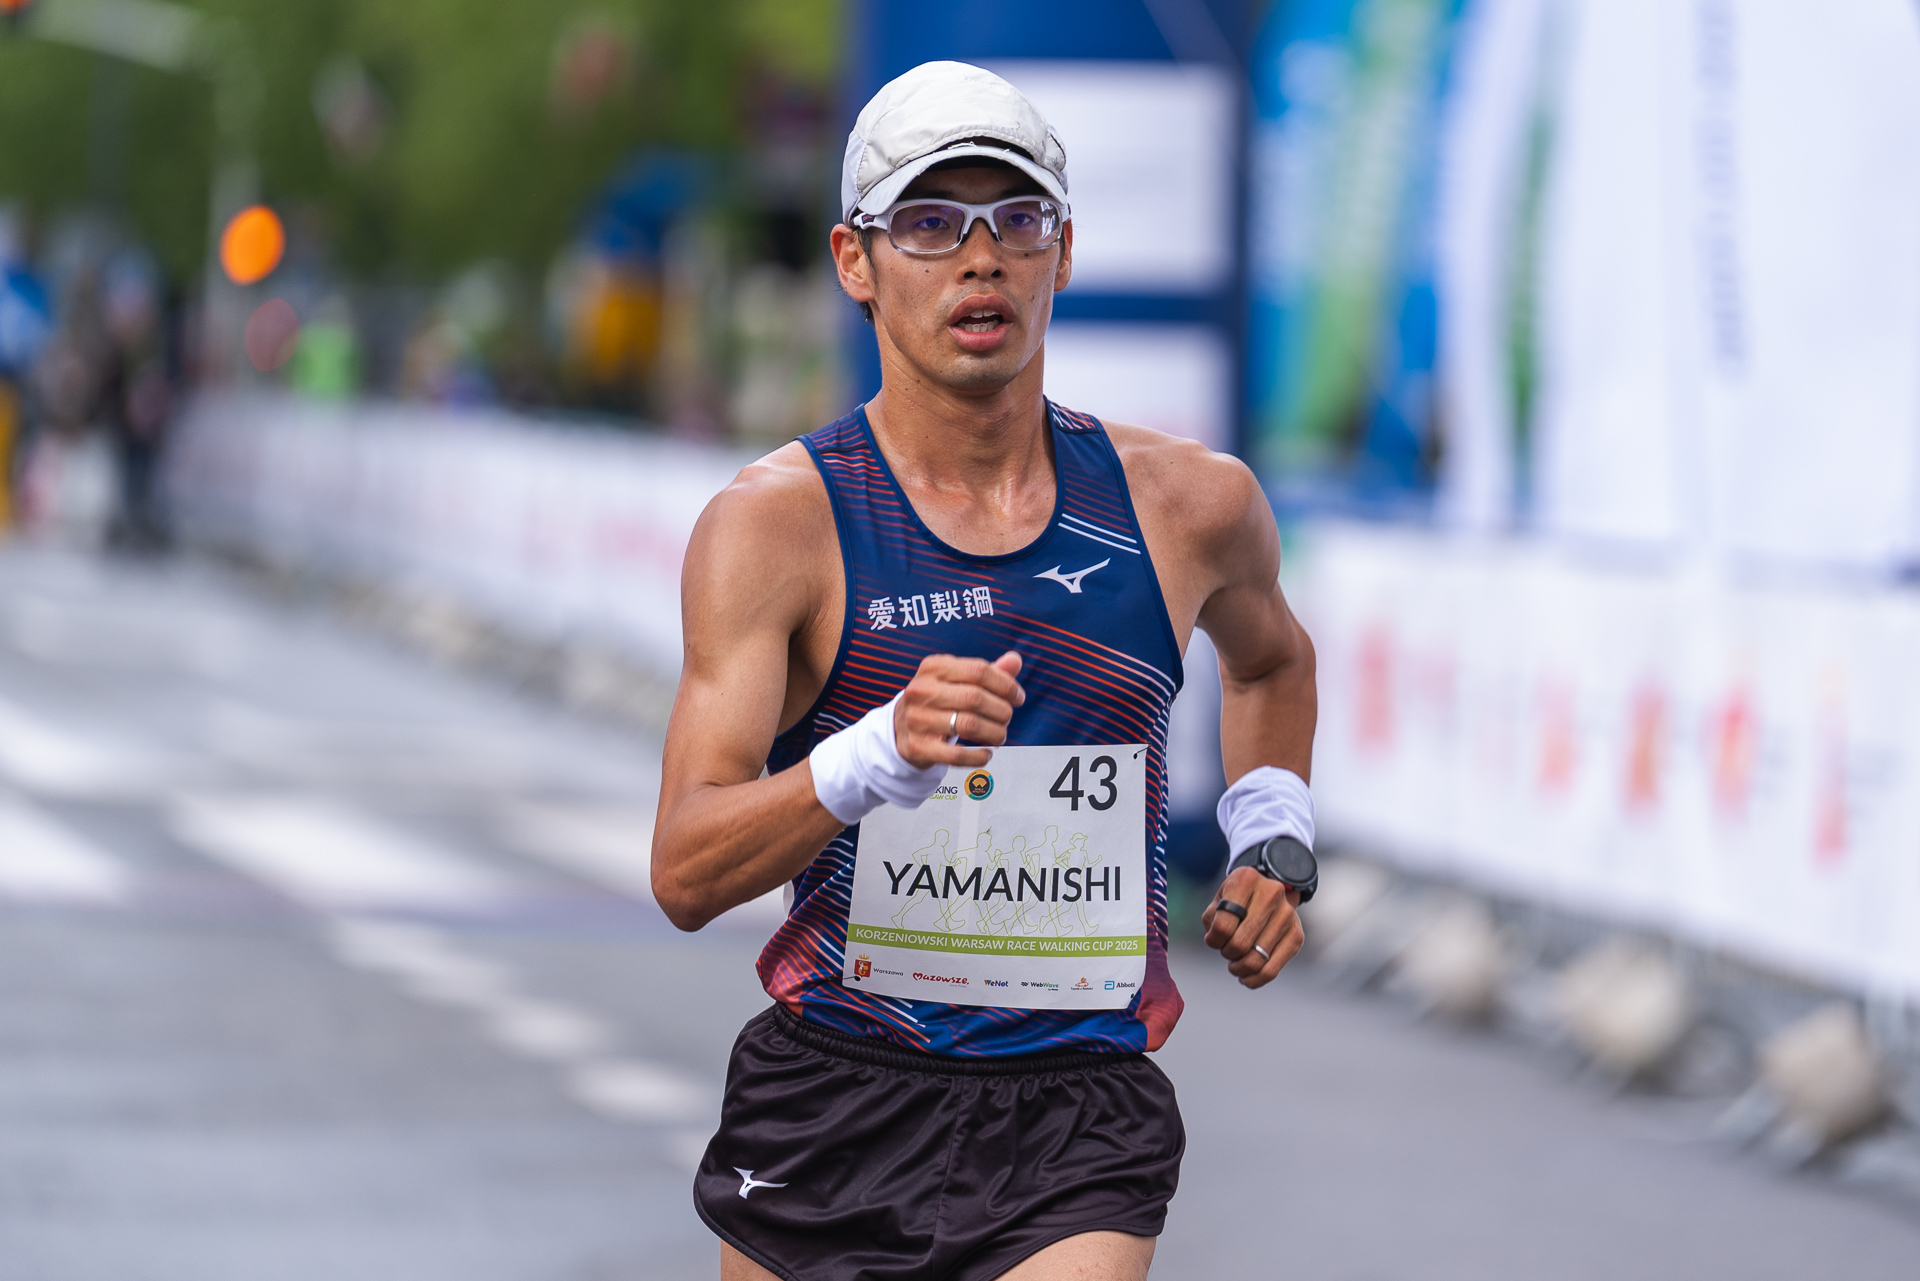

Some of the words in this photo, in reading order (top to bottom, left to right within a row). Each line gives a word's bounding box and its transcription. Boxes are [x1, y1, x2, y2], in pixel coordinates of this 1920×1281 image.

[868, 586, 994, 630] 愛知製鋼
[1049, 755, 1118, 811] 43
[882, 860, 1121, 902] YAMANISHI
[856, 928, 948, 947] KORZENIOWSKI
[951, 937, 1005, 950] WARSAW
[1006, 940, 1037, 951] RACE
[1039, 941, 1090, 952] WALKING
[1092, 940, 1114, 951] CUP
[1115, 940, 1138, 951] 2025
[873, 967, 904, 976] Warszawa
